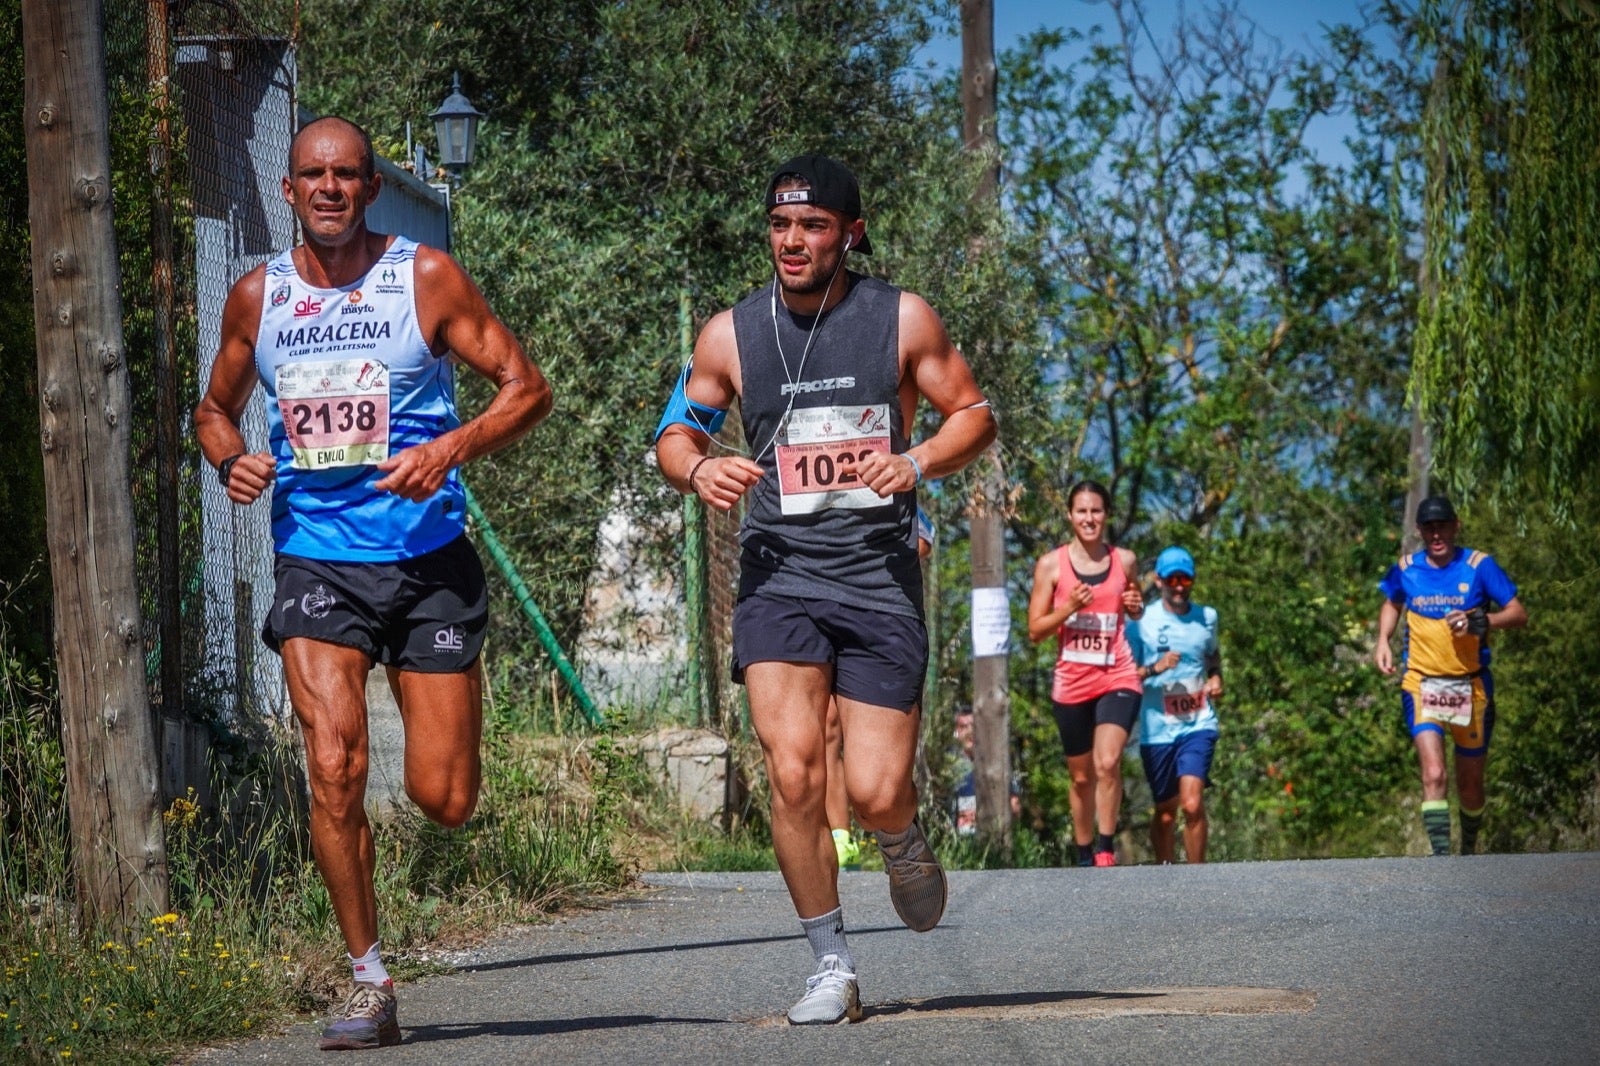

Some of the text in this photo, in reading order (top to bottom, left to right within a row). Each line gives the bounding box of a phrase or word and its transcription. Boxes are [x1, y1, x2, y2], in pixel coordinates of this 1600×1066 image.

[294, 295, 321, 317] als
[276, 321, 391, 349] MARACENA
[289, 348, 310, 357] CLUB
[326, 343, 376, 352] ATLETISMO
[781, 377, 856, 396] PROZIS
[292, 400, 376, 436] 2138
[433, 625, 463, 650] als
